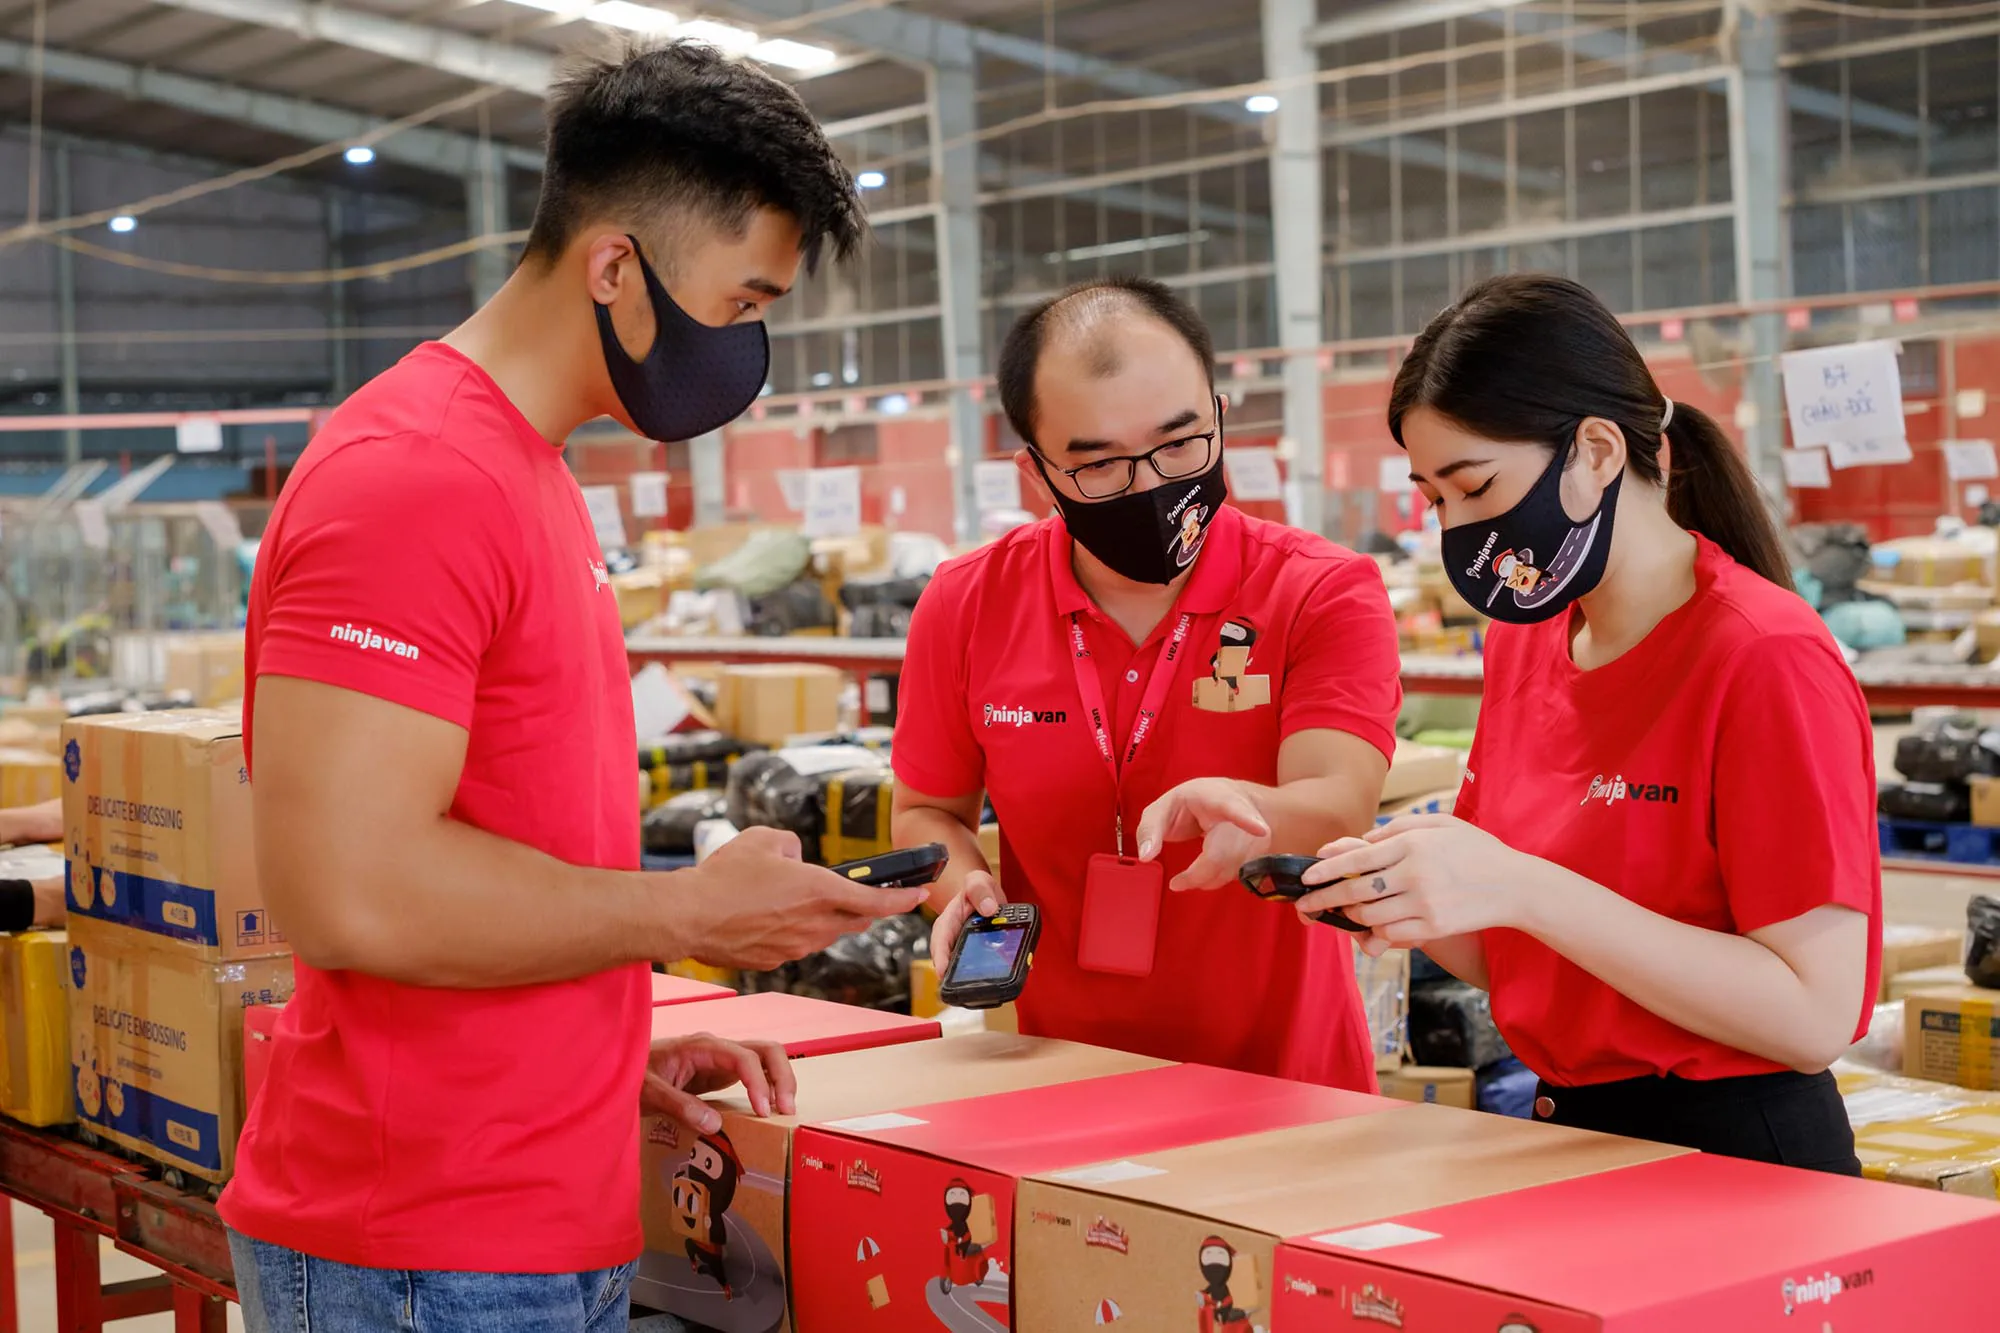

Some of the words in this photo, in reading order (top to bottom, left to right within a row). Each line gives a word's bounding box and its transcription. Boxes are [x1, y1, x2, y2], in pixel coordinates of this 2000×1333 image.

[1172, 484, 1201, 518] ninjavan
[1473, 531, 1499, 572] ninjavan
[329, 623, 420, 661] ninjavan
[1165, 614, 1190, 661] ninjavan
[992, 705, 1067, 728] ninjavan
[1091, 708, 1109, 757] ninjavan
[1126, 716, 1149, 763] ninjavan
[1591, 774, 1679, 806] nijavan
[88, 795, 127, 821] DELICATE
[129, 802, 183, 830] EMBOSSING
[93, 1004, 133, 1035] DELICATE
[134, 1016, 187, 1052] EMBOSSING
[1795, 1268, 1874, 1304] ninjavan
